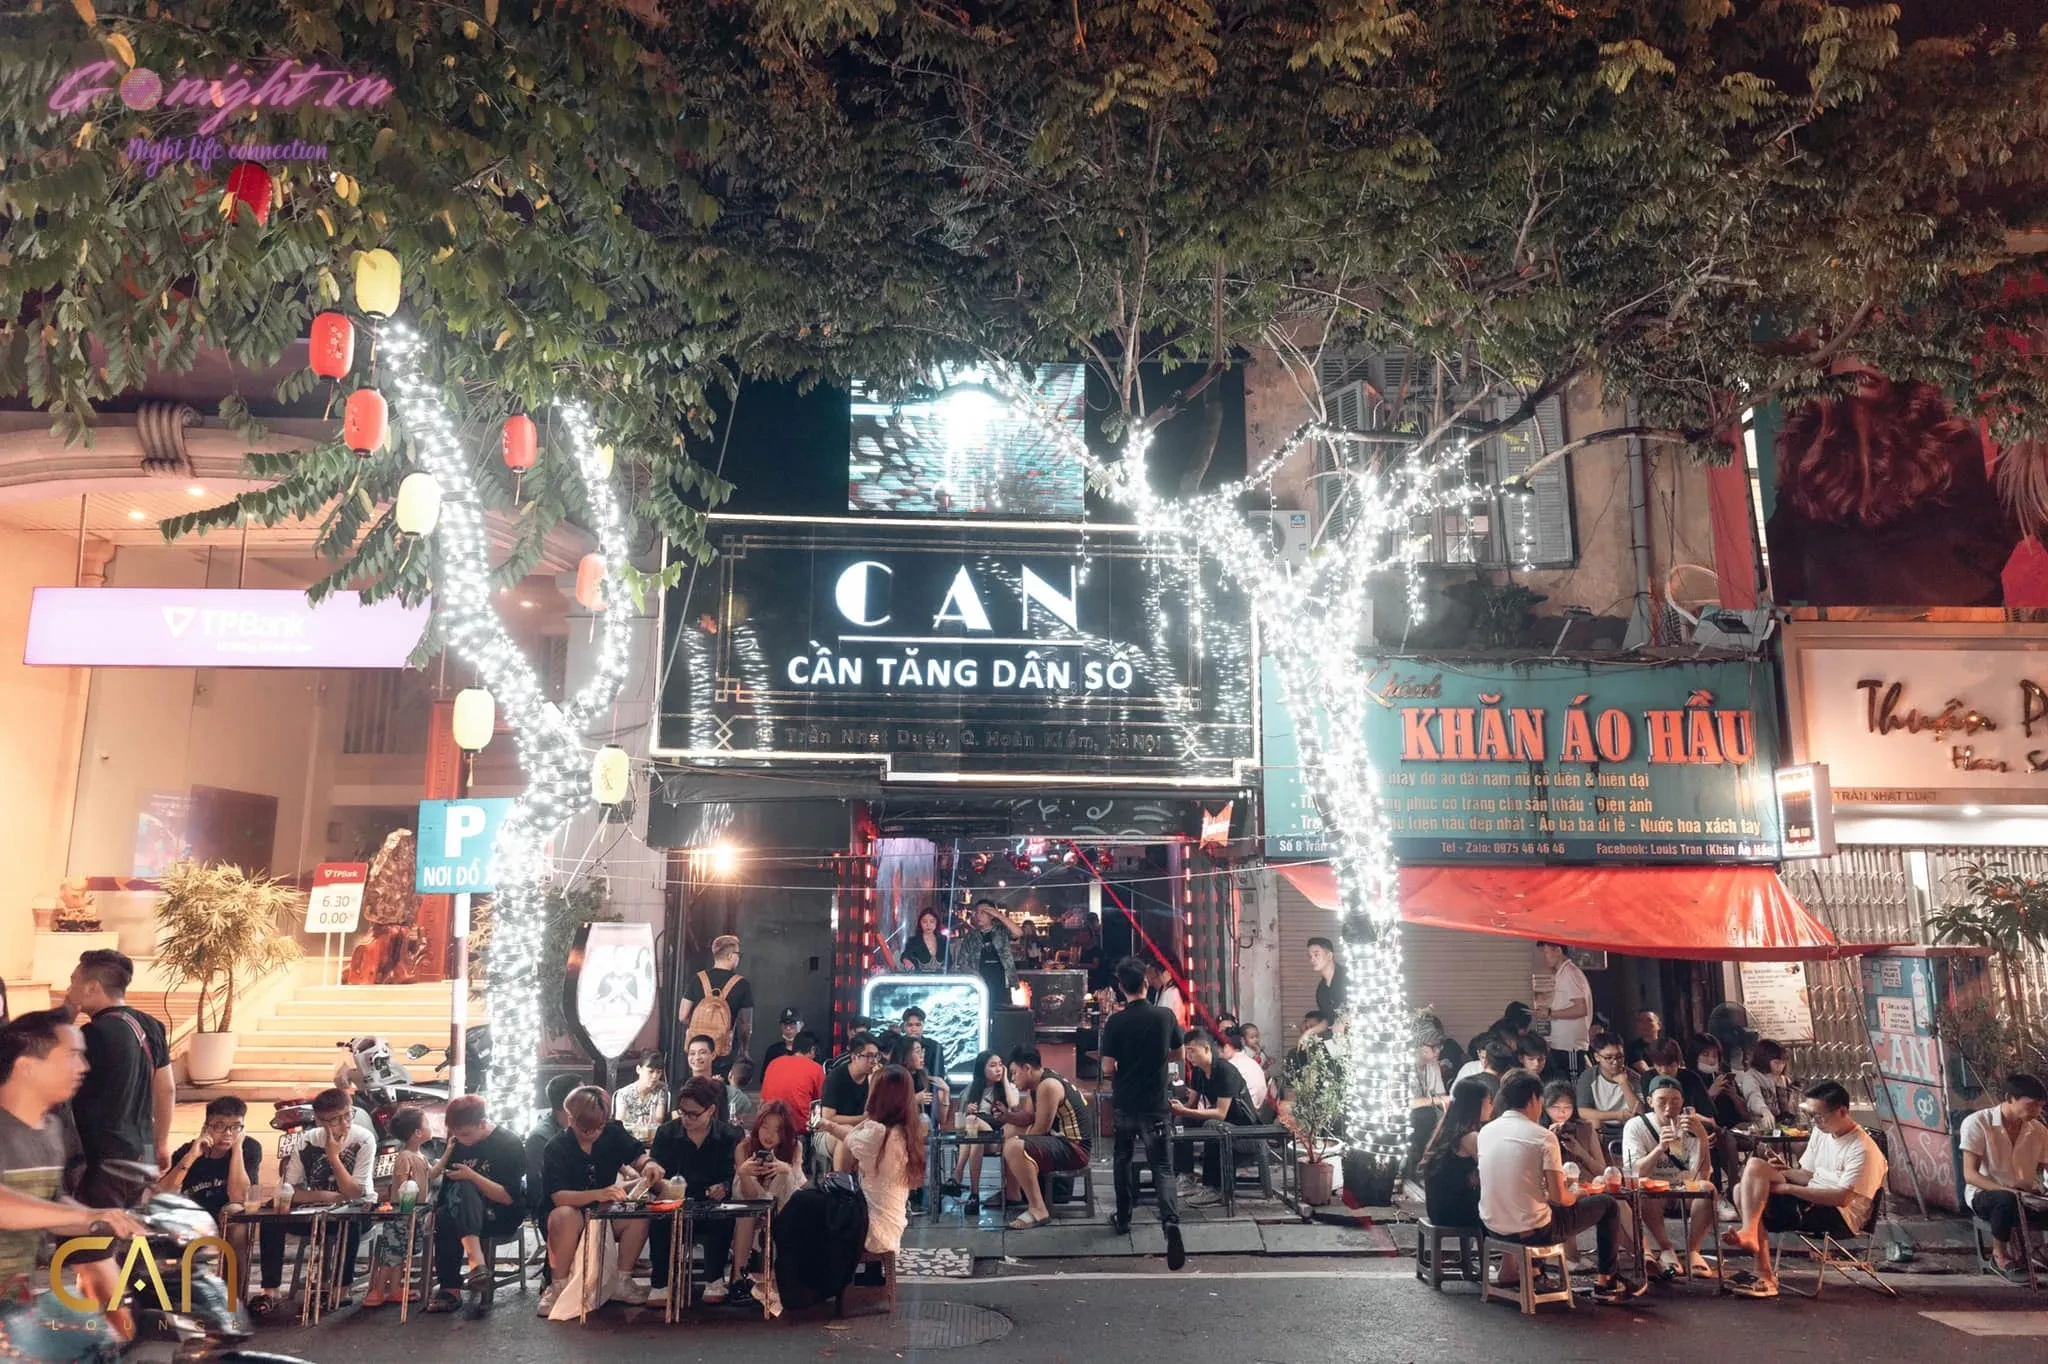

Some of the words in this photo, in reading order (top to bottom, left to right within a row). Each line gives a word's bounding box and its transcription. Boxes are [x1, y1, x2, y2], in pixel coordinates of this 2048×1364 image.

[834, 560, 1079, 633] CAN
[200, 607, 306, 638] TPBank
[787, 640, 863, 686] CẦN
[876, 646, 978, 688] TĂNG
[992, 650, 1071, 690] DÂN
[1400, 691, 1546, 763] KHĂN
[1559, 692, 1633, 764] ÁO
[1643, 688, 1754, 765] HẦU
[444, 805, 487, 858] P
[1677, 817, 1702, 833] hoa
[1705, 816, 1737, 835] xách
[1741, 818, 1762, 837] tay
[1279, 839, 1294, 852] Số
[1441, 841, 1457, 853] Tel
[1465, 841, 1492, 854] Zalo:
[1494, 842, 1519, 854] 0975
[1521, 842, 1535, 854] 46
[1537, 842, 1550, 854] 46
[1552, 842, 1565, 854] 46
[1596, 842, 1649, 855] Facebook:
[1650, 843, 1678, 855] Louis
[423, 864, 452, 888] NƠI
[322, 895, 351, 908] 6.30
[319, 911, 347, 925] 0.00
